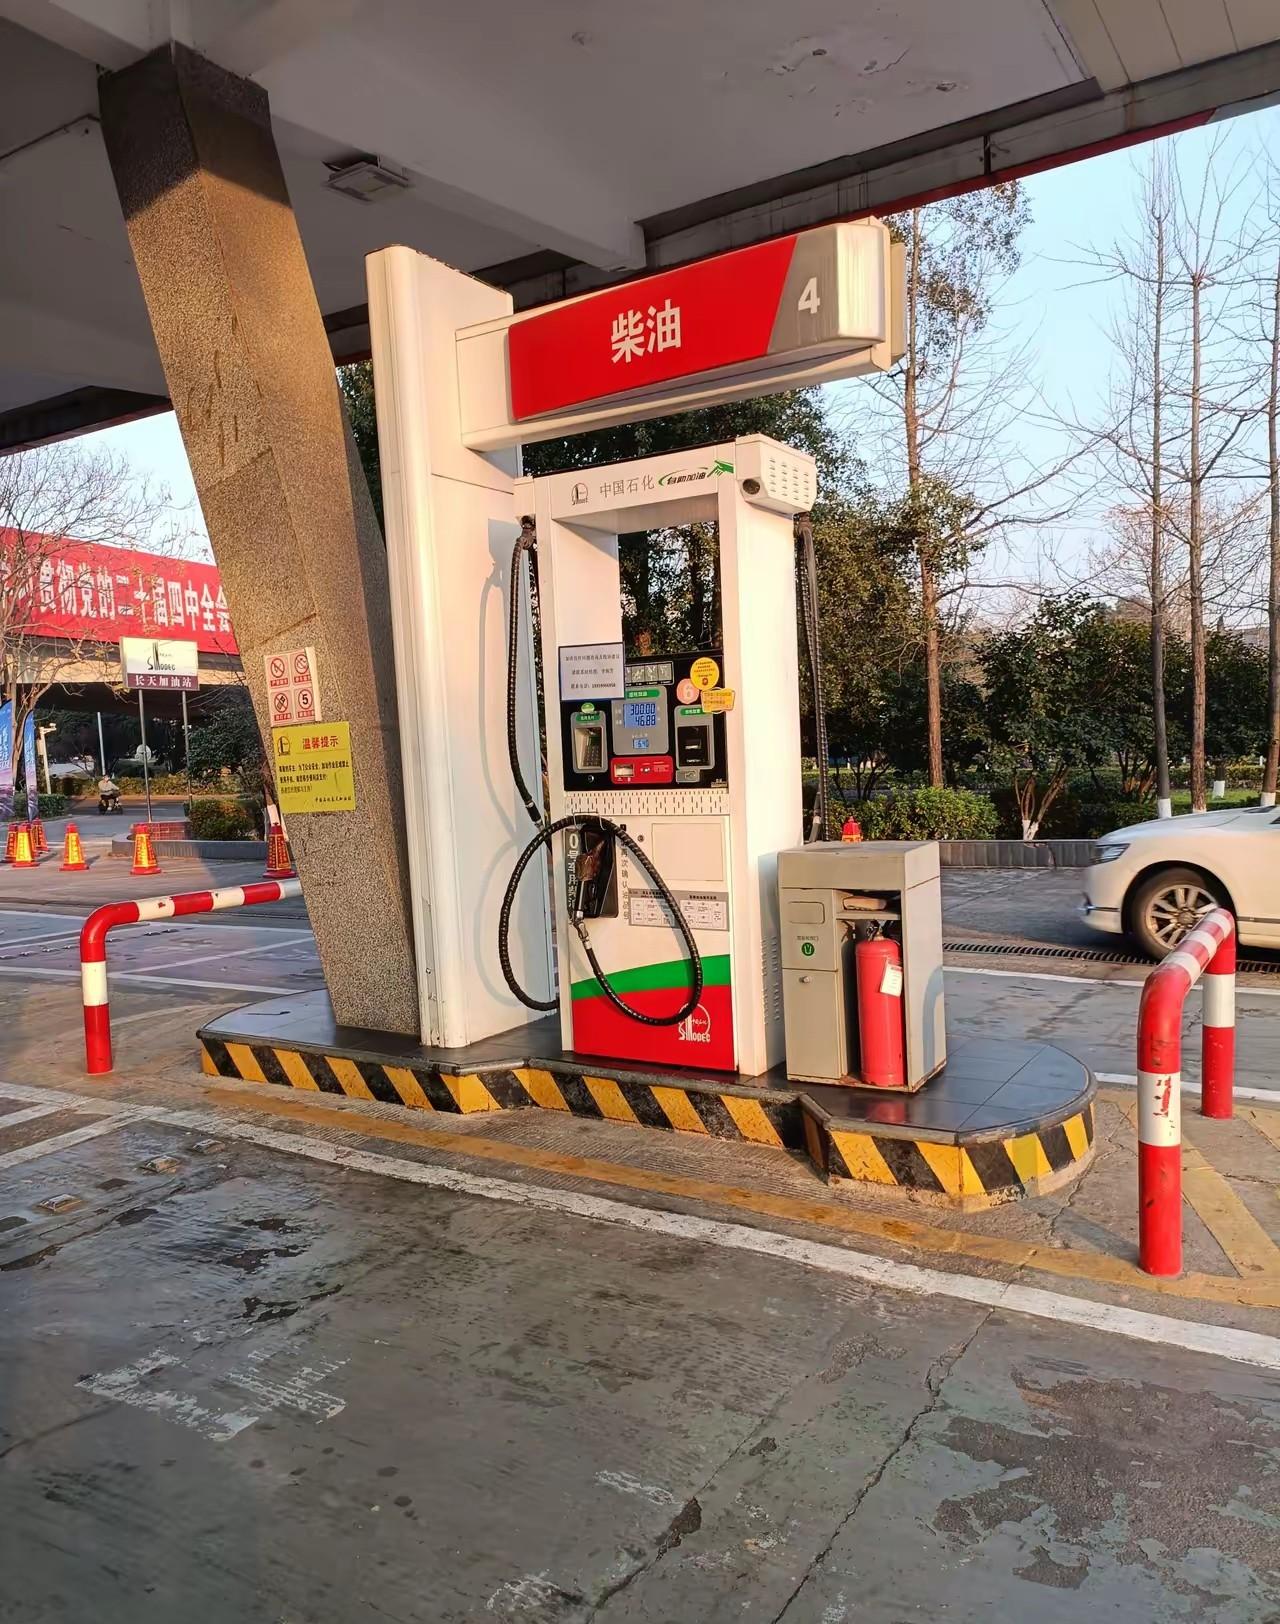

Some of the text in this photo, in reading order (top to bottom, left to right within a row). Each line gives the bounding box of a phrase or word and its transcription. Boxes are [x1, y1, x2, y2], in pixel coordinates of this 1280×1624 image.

[798, 277, 820, 314] 4
[611, 299, 682, 363] 柴油
[600, 475, 655, 498] 中国石化
[135, 675, 192, 688] 长天加油站
[302, 693, 309, 705] 5
[303, 736, 339, 750] 温馨提示
